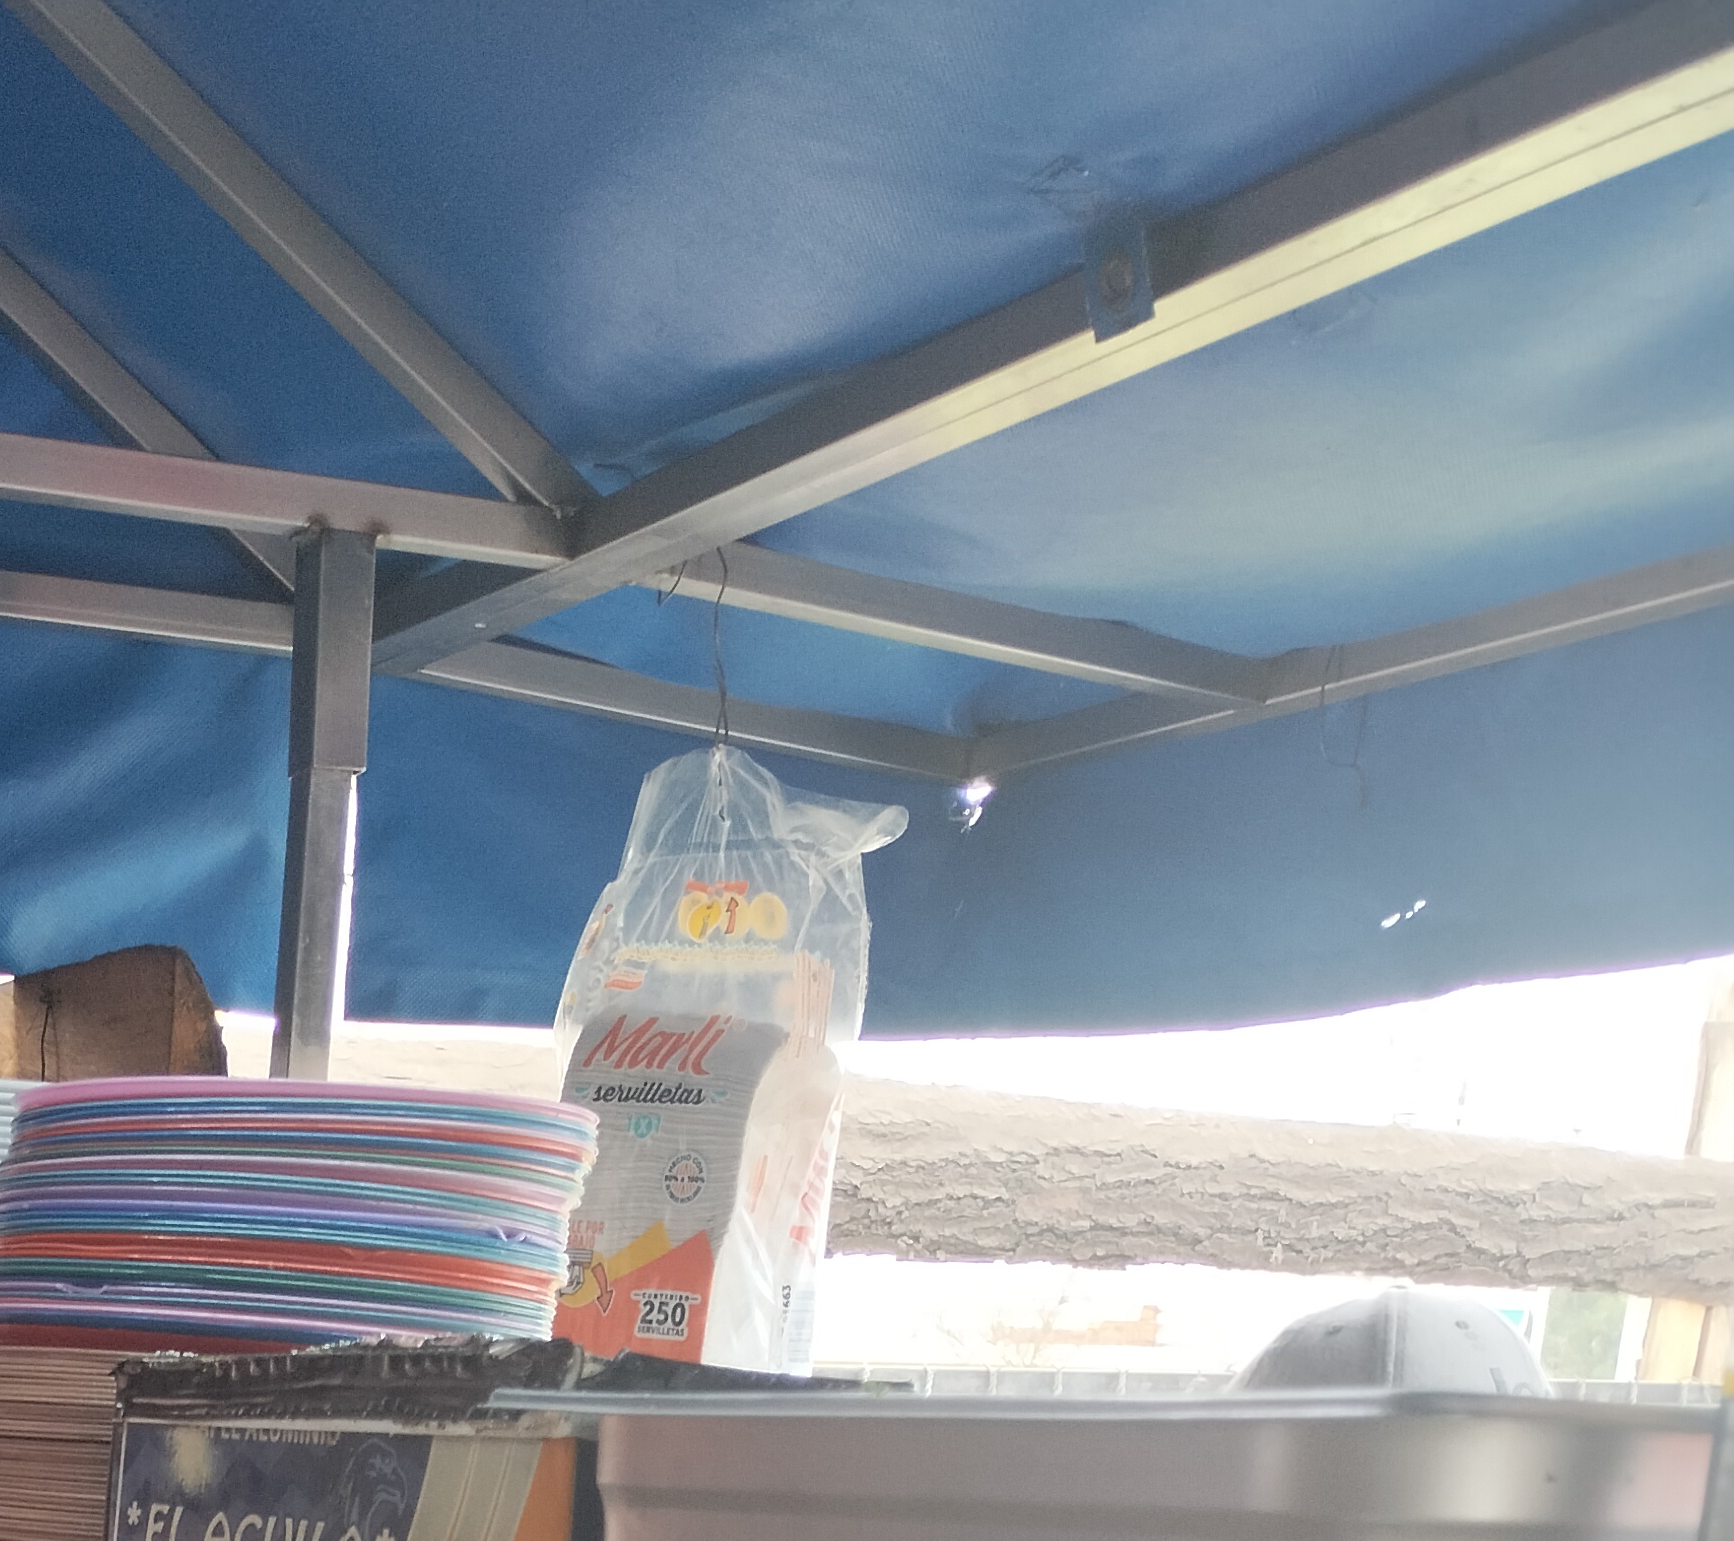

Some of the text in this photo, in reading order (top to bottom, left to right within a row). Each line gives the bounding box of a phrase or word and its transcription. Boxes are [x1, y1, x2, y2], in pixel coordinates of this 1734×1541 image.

[581, 1013, 733, 1076] Marli
[592, 1081, 706, 1106] servilletas
[639, 1299, 686, 1327] 250
[637, 1325, 685, 1337] SERVILLETAS
